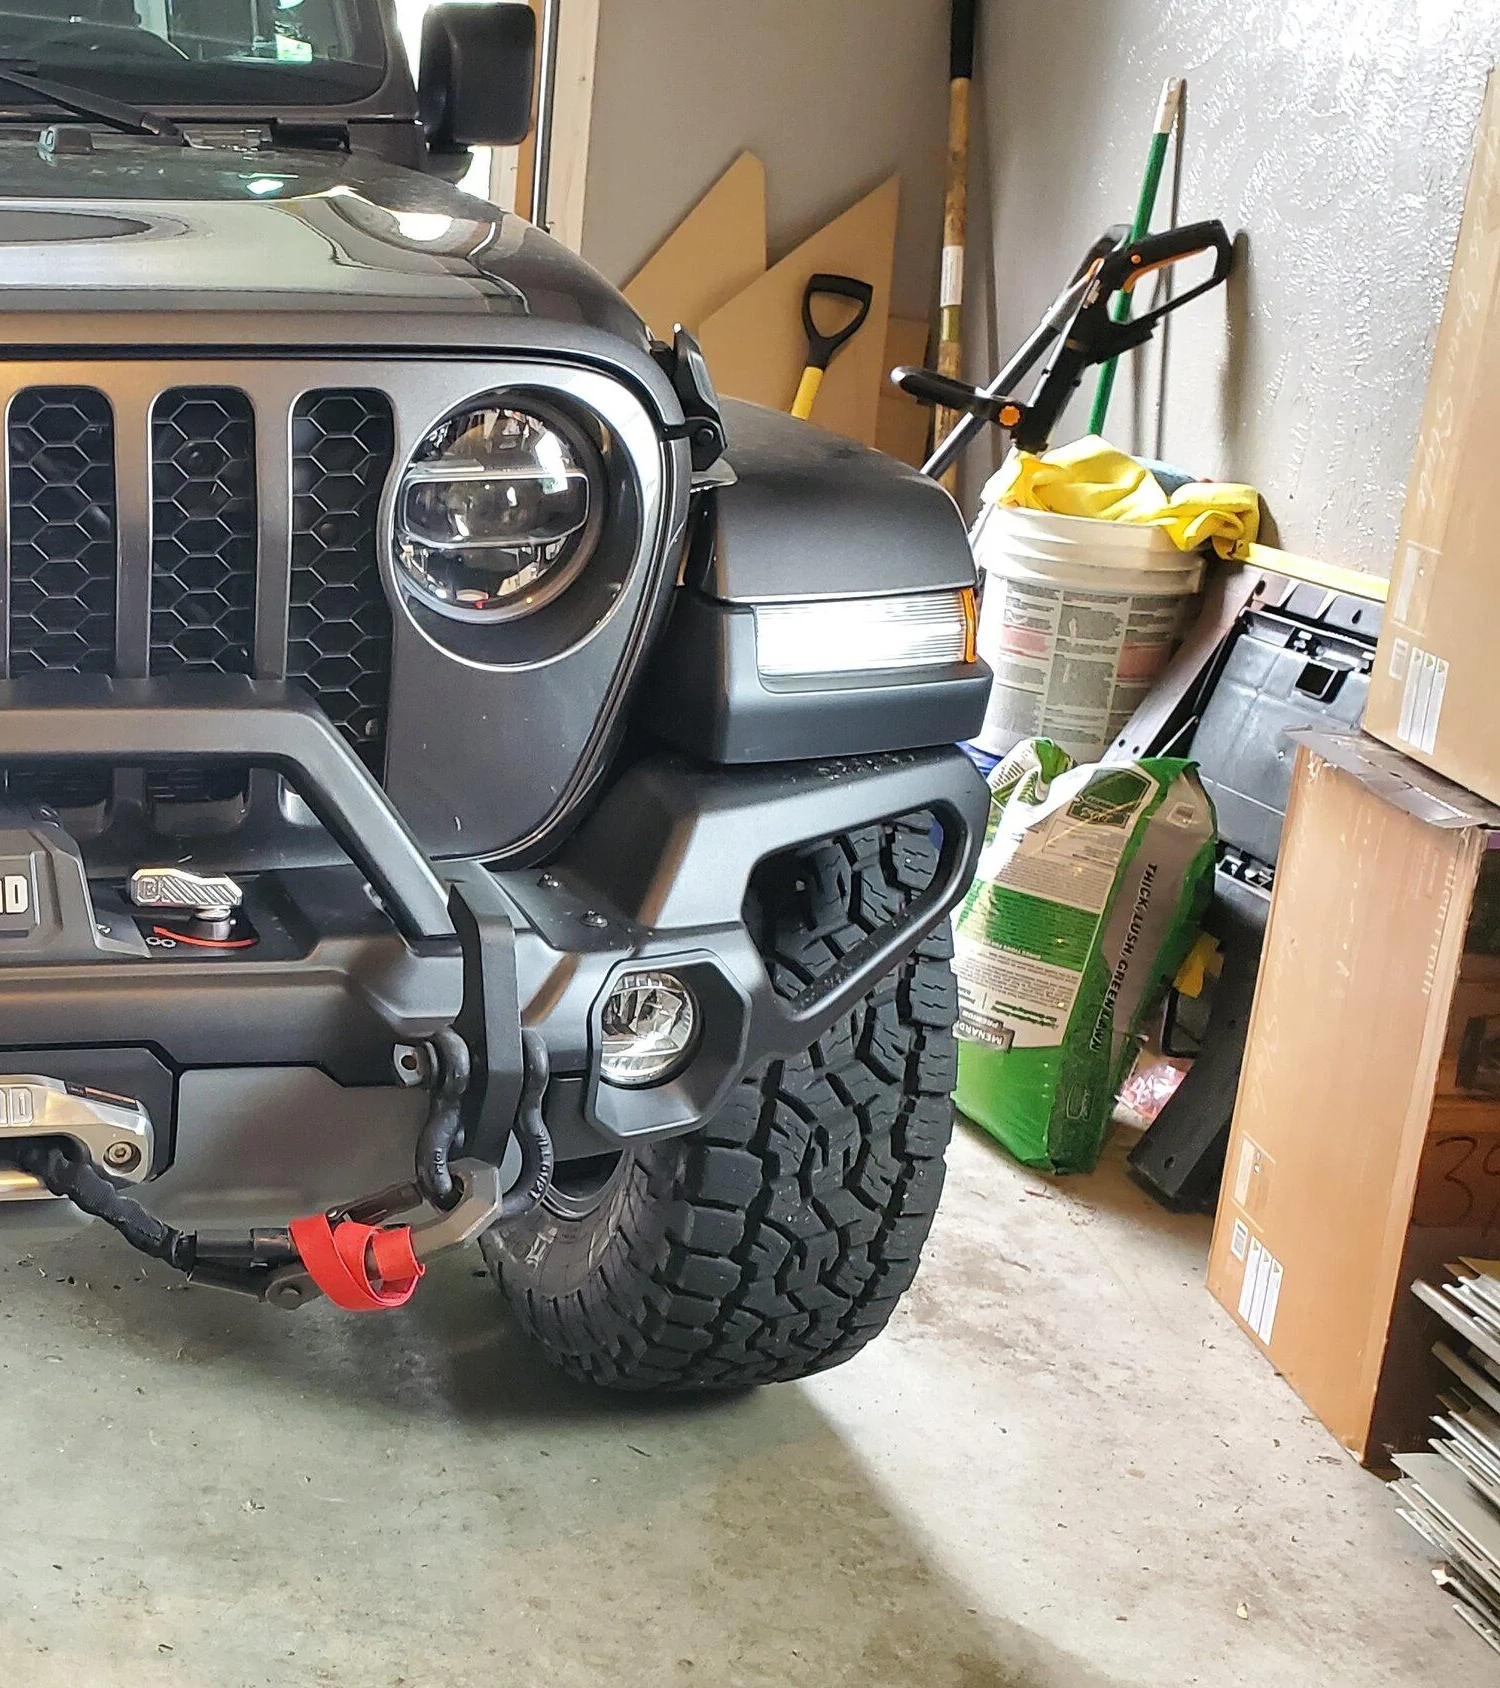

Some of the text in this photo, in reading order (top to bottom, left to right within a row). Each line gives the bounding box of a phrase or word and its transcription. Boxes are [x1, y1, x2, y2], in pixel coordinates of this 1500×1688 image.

[1089, 862, 1158, 1051] THICK, LUSH, GREEN LAWN
